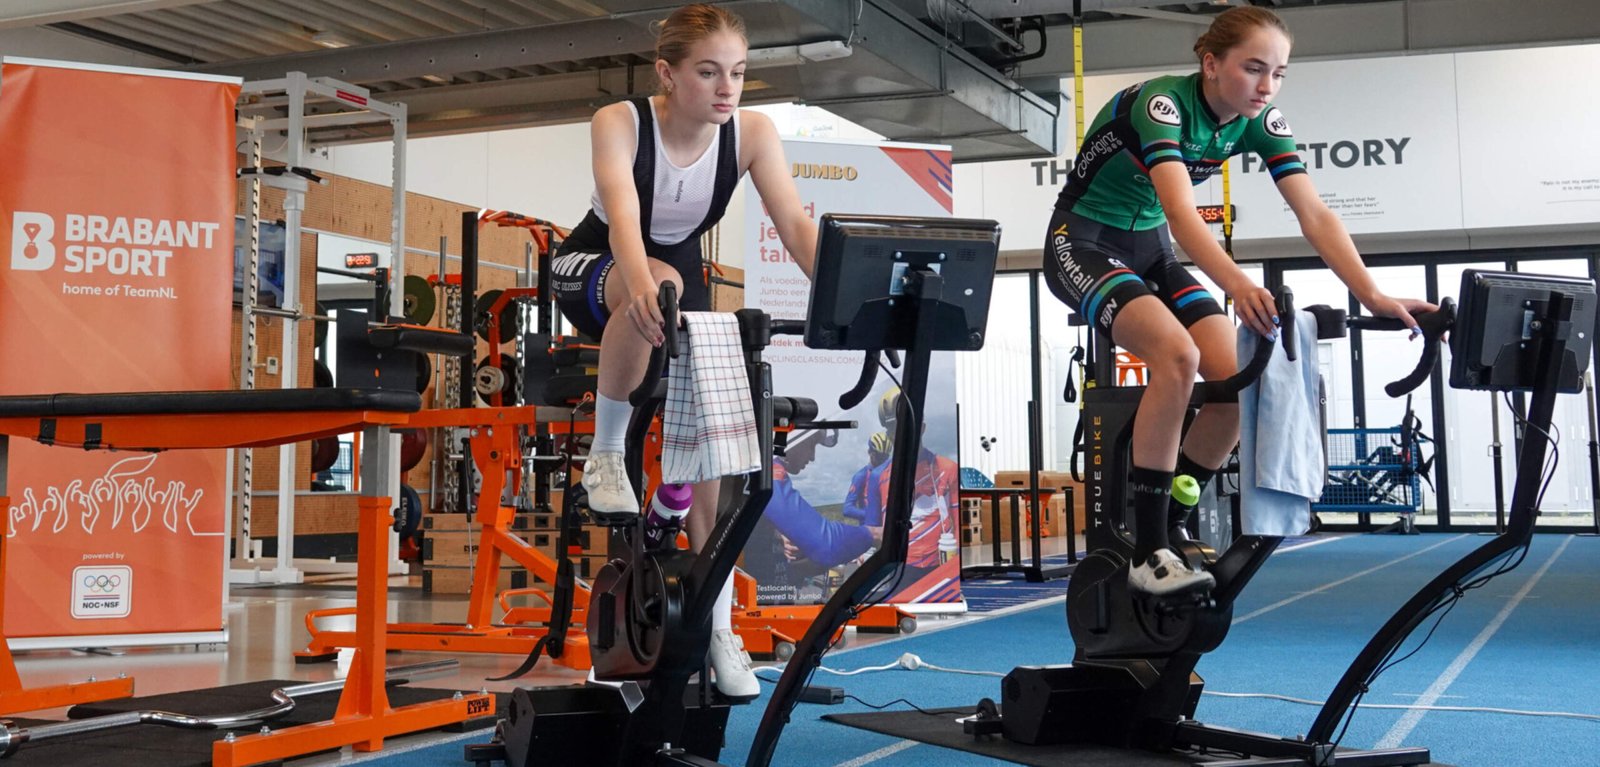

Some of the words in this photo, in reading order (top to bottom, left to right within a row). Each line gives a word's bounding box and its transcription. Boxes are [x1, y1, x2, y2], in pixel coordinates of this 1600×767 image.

[792, 163, 858, 181] JUMBO
[1031, 159, 1073, 186] TH
[1242, 137, 1411, 174] FTORY
[65, 214, 220, 249] BRABANT
[64, 246, 173, 277] SPORT
[1054, 224, 1094, 293] Yellowtail
[62, 283, 101, 295] home
[105, 284, 120, 296] of
[122, 285, 178, 299] TeamNL
[775, 276, 808, 286] voeding
[82, 552, 114, 560] powered
[115, 552, 125, 560] by
